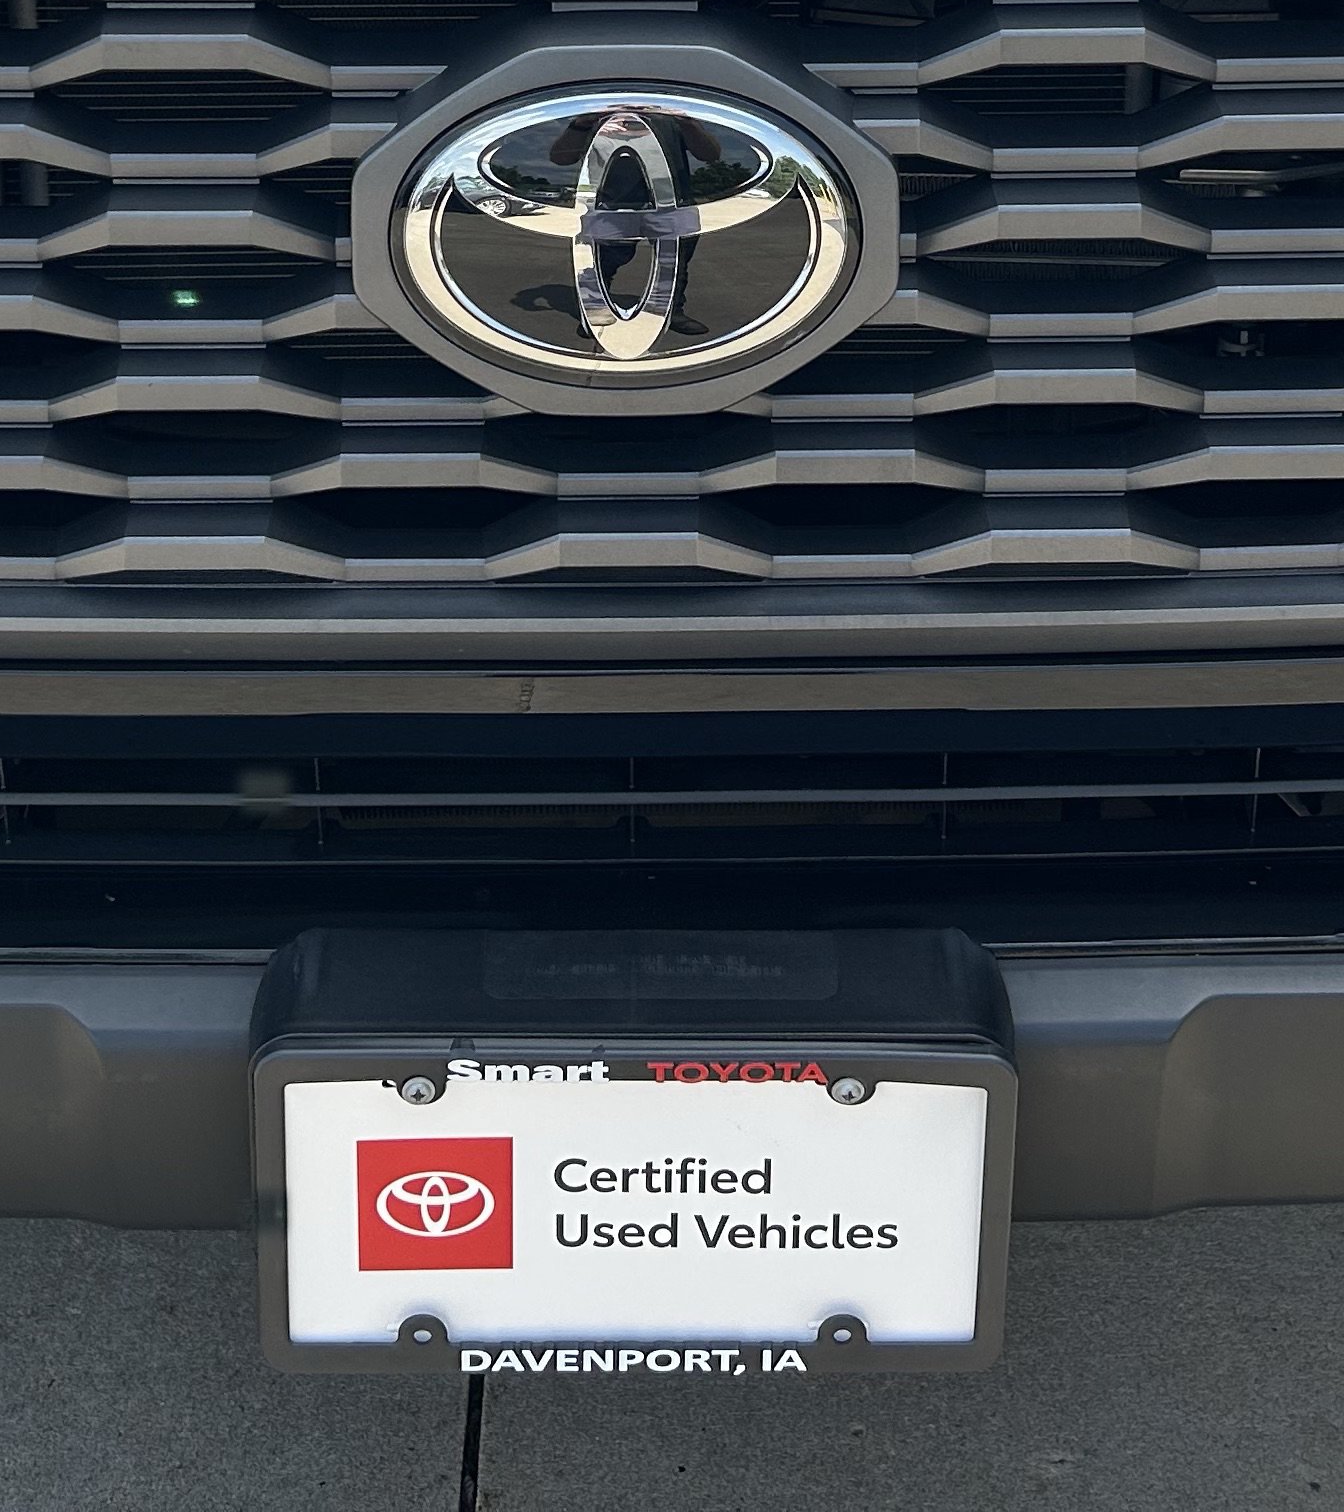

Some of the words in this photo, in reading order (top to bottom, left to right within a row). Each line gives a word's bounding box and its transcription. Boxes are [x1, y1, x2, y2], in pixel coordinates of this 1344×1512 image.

[446, 1058, 610, 1084] Smart
[647, 1061, 828, 1086] TOYOTA
[554, 1157, 773, 1196] Certified
[555, 1213, 679, 1250] Used
[694, 1213, 899, 1251] Vehicles
[459, 1348, 747, 1377] DAVENPORT,
[760, 1348, 808, 1372] IA
